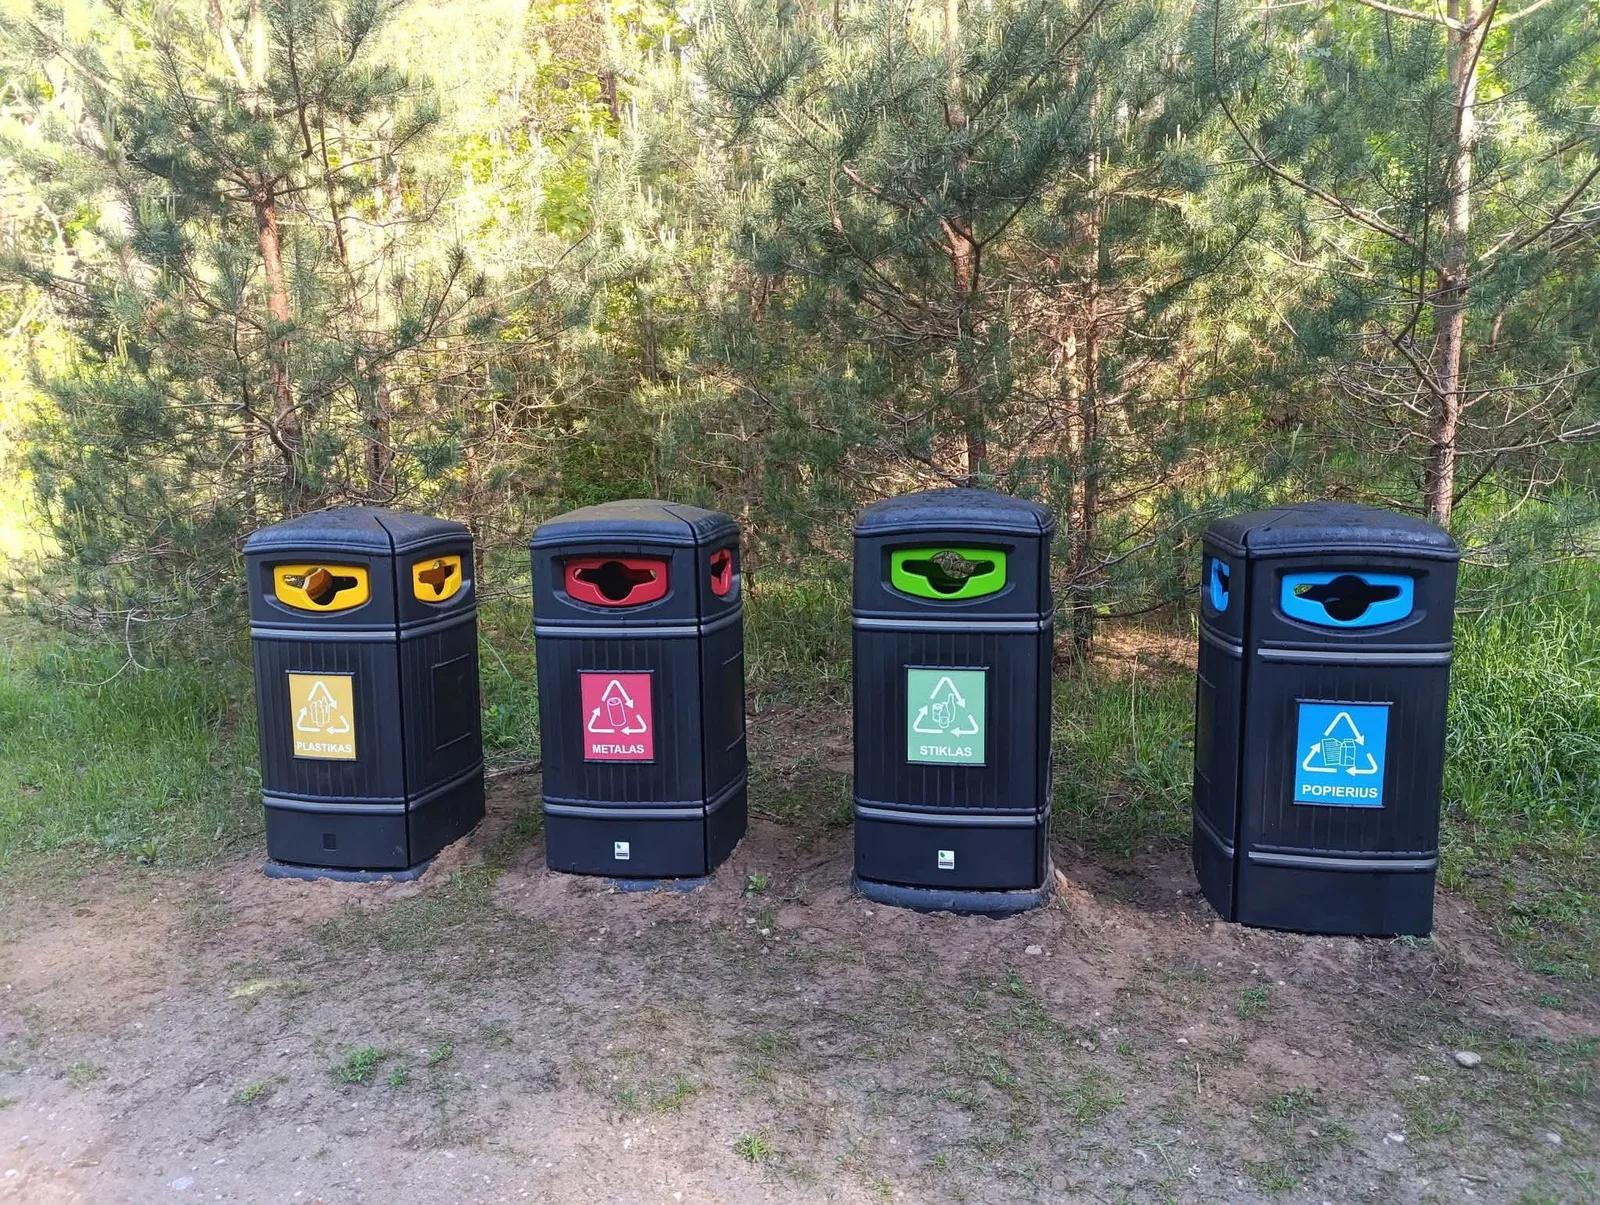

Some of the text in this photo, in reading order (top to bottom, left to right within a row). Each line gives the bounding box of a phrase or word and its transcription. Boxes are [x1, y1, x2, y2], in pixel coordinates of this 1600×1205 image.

[296, 741, 352, 753] PLASTIKAS
[592, 744, 645, 754] METALAS
[920, 745, 972, 757] STIKLAS
[1302, 784, 1378, 798] POPIERIUS
